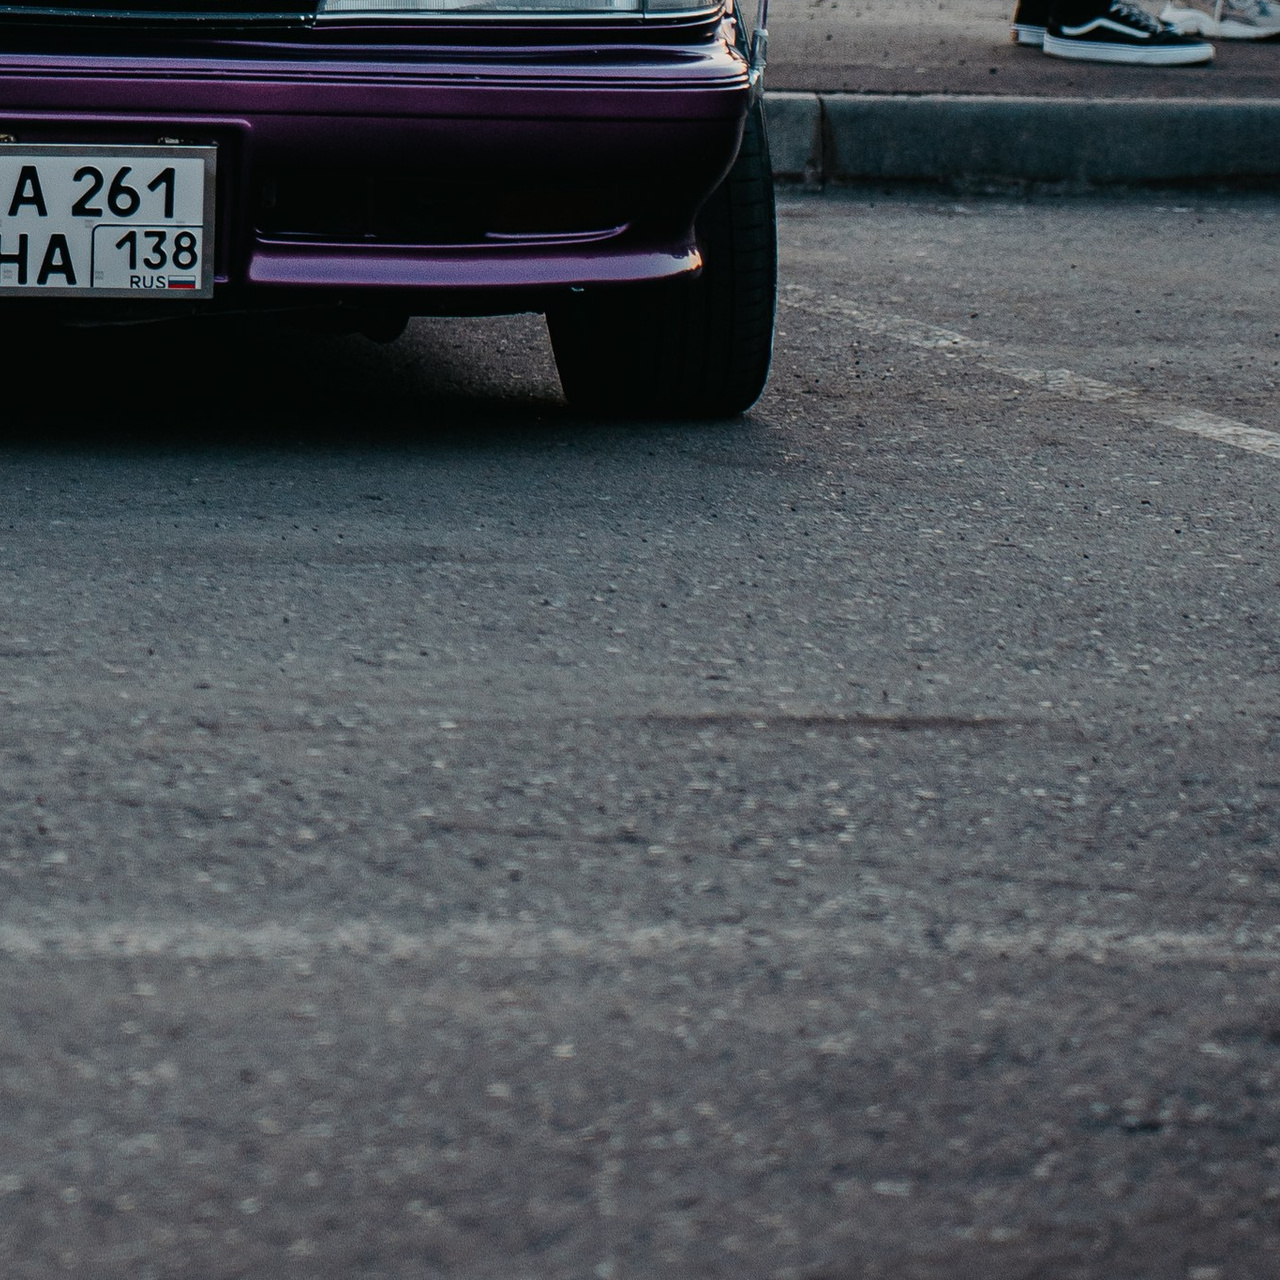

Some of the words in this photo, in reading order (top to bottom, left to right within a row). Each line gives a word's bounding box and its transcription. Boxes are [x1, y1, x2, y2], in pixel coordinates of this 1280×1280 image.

[71, 165, 176, 219] 261
[115, 230, 198, 270] 138
[130, 275, 166, 289] RUS
